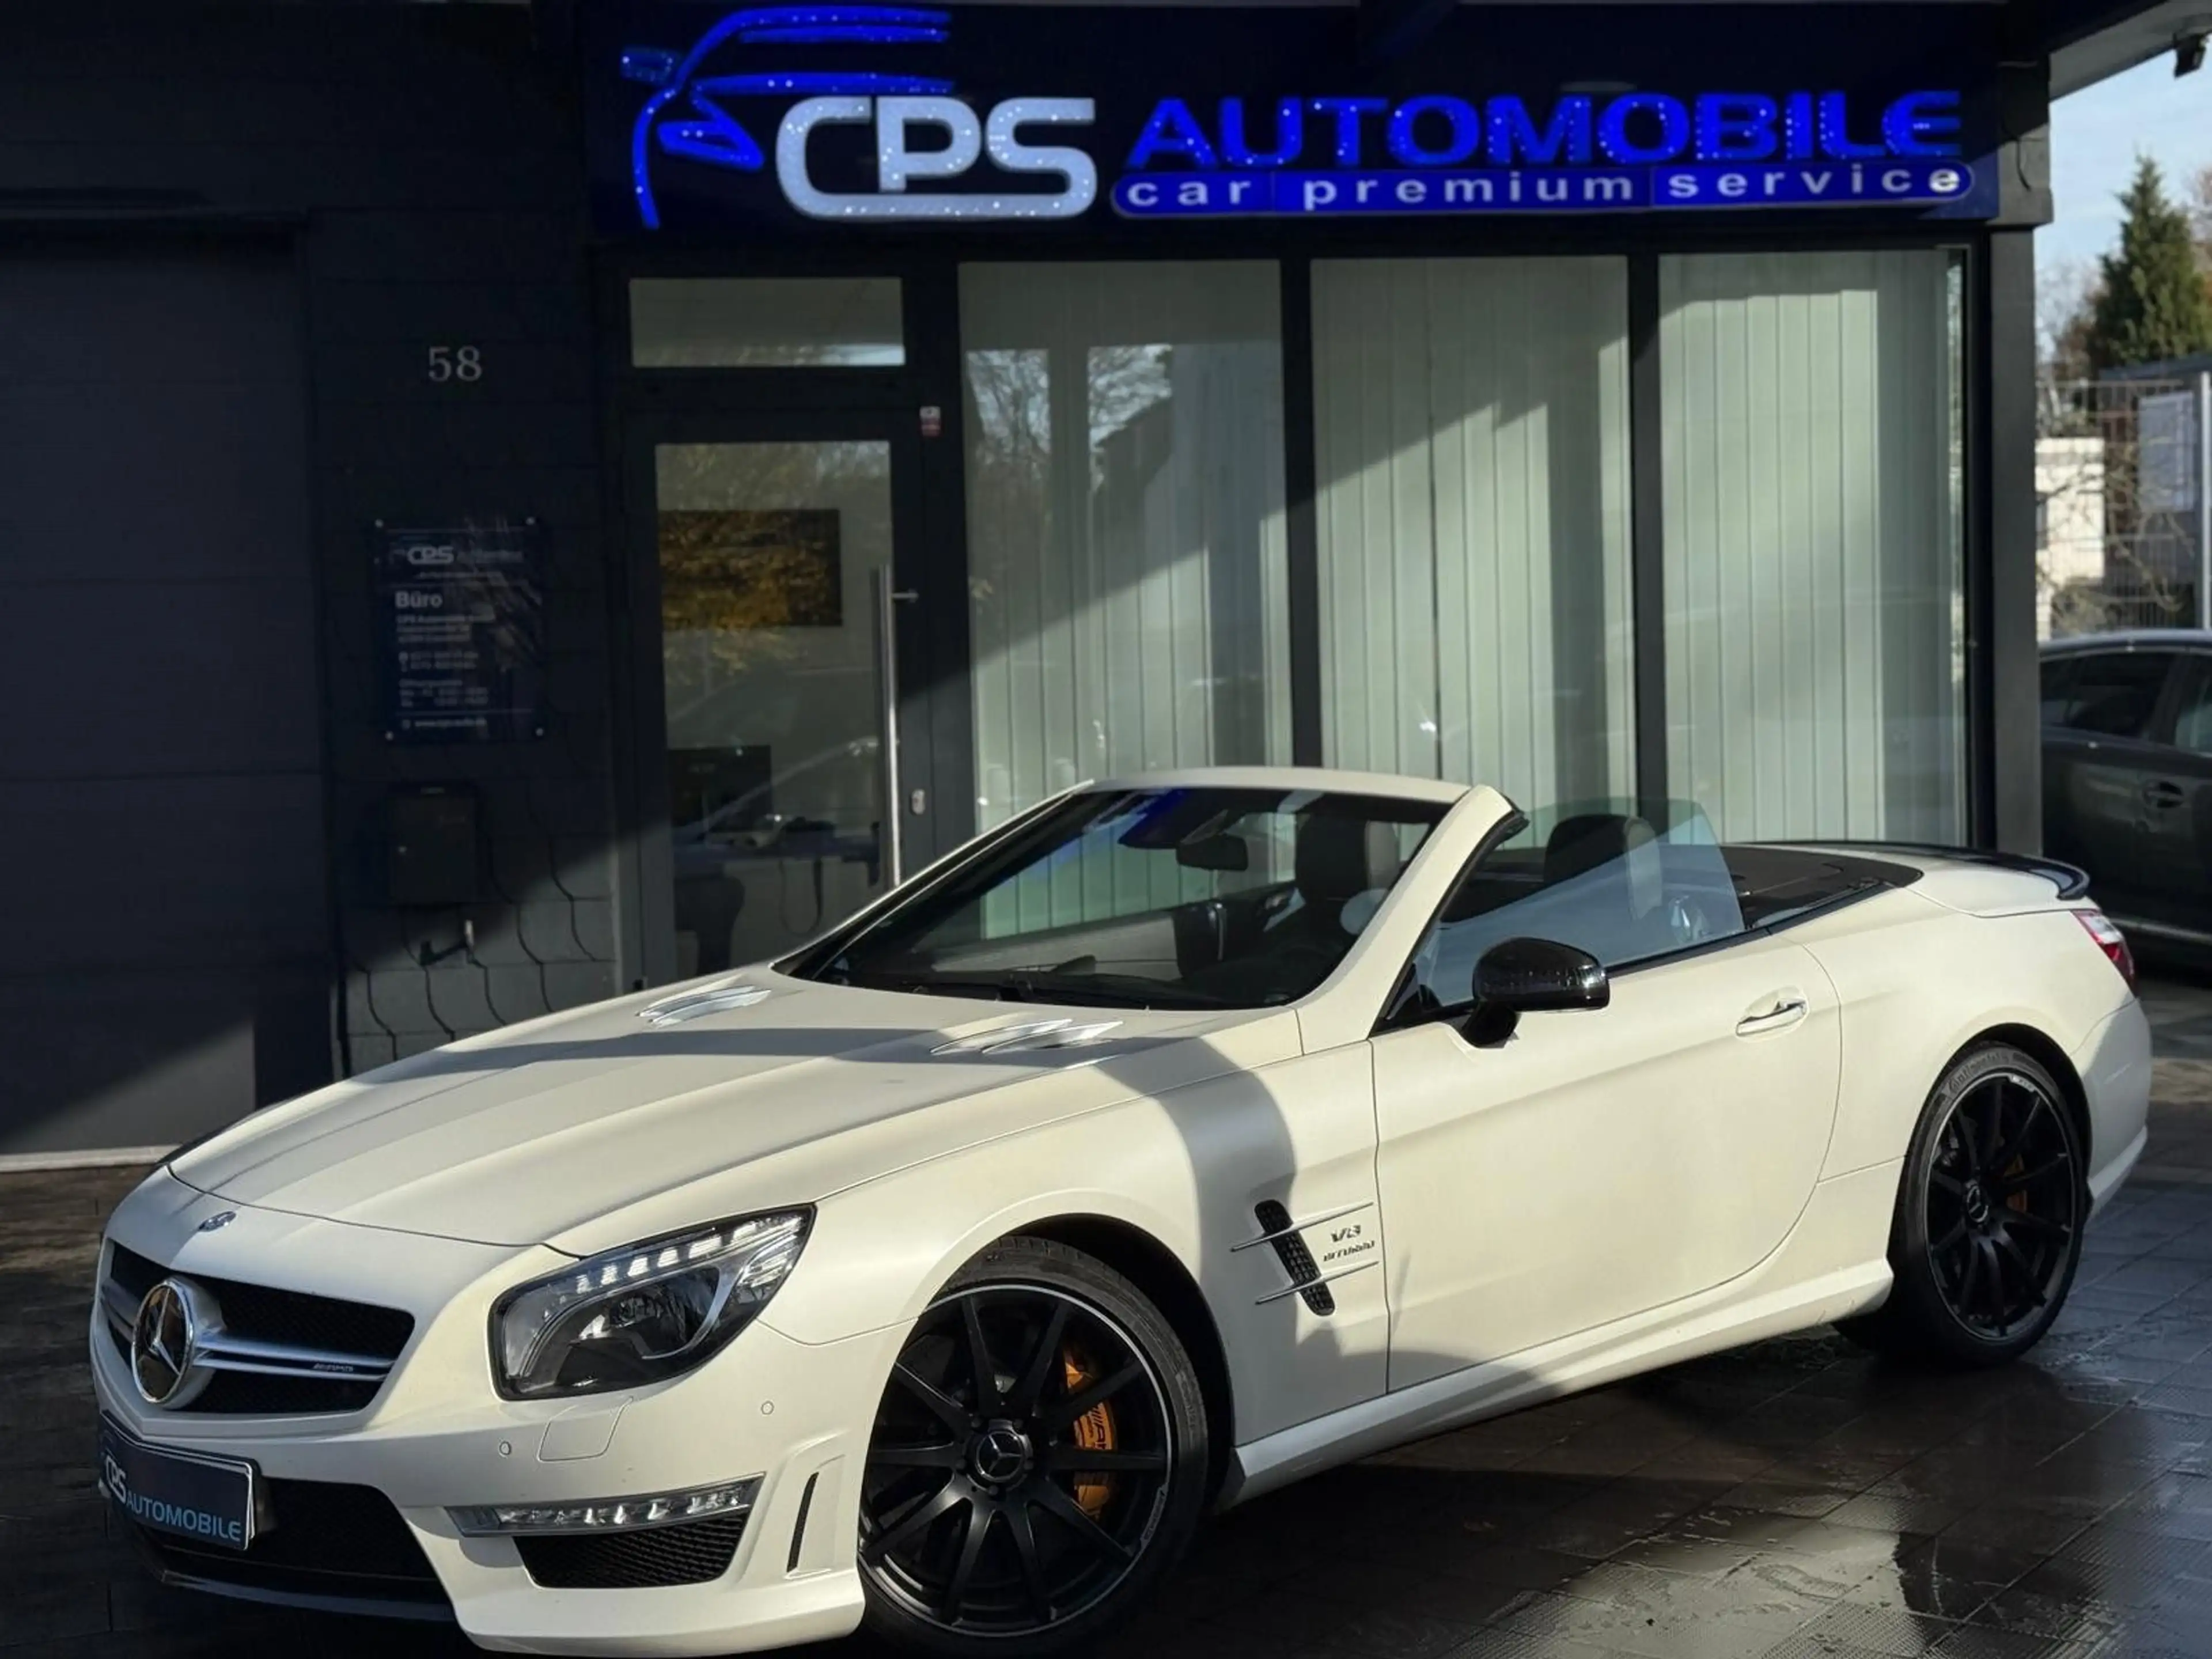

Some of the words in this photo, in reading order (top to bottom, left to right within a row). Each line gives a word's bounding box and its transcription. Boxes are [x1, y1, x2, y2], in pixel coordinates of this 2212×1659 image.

[776, 96, 1097, 218] CPS
[1126, 90, 1962, 168] AUTOMOBILE
[1127, 179, 1251, 206] car
[1303, 171, 1633, 211] premium
[1668, 164, 1959, 198] service
[429, 346, 482, 381] 58
[395, 591, 443, 609] Büro
[126, 1493, 242, 1542] AUTOMOBILE
